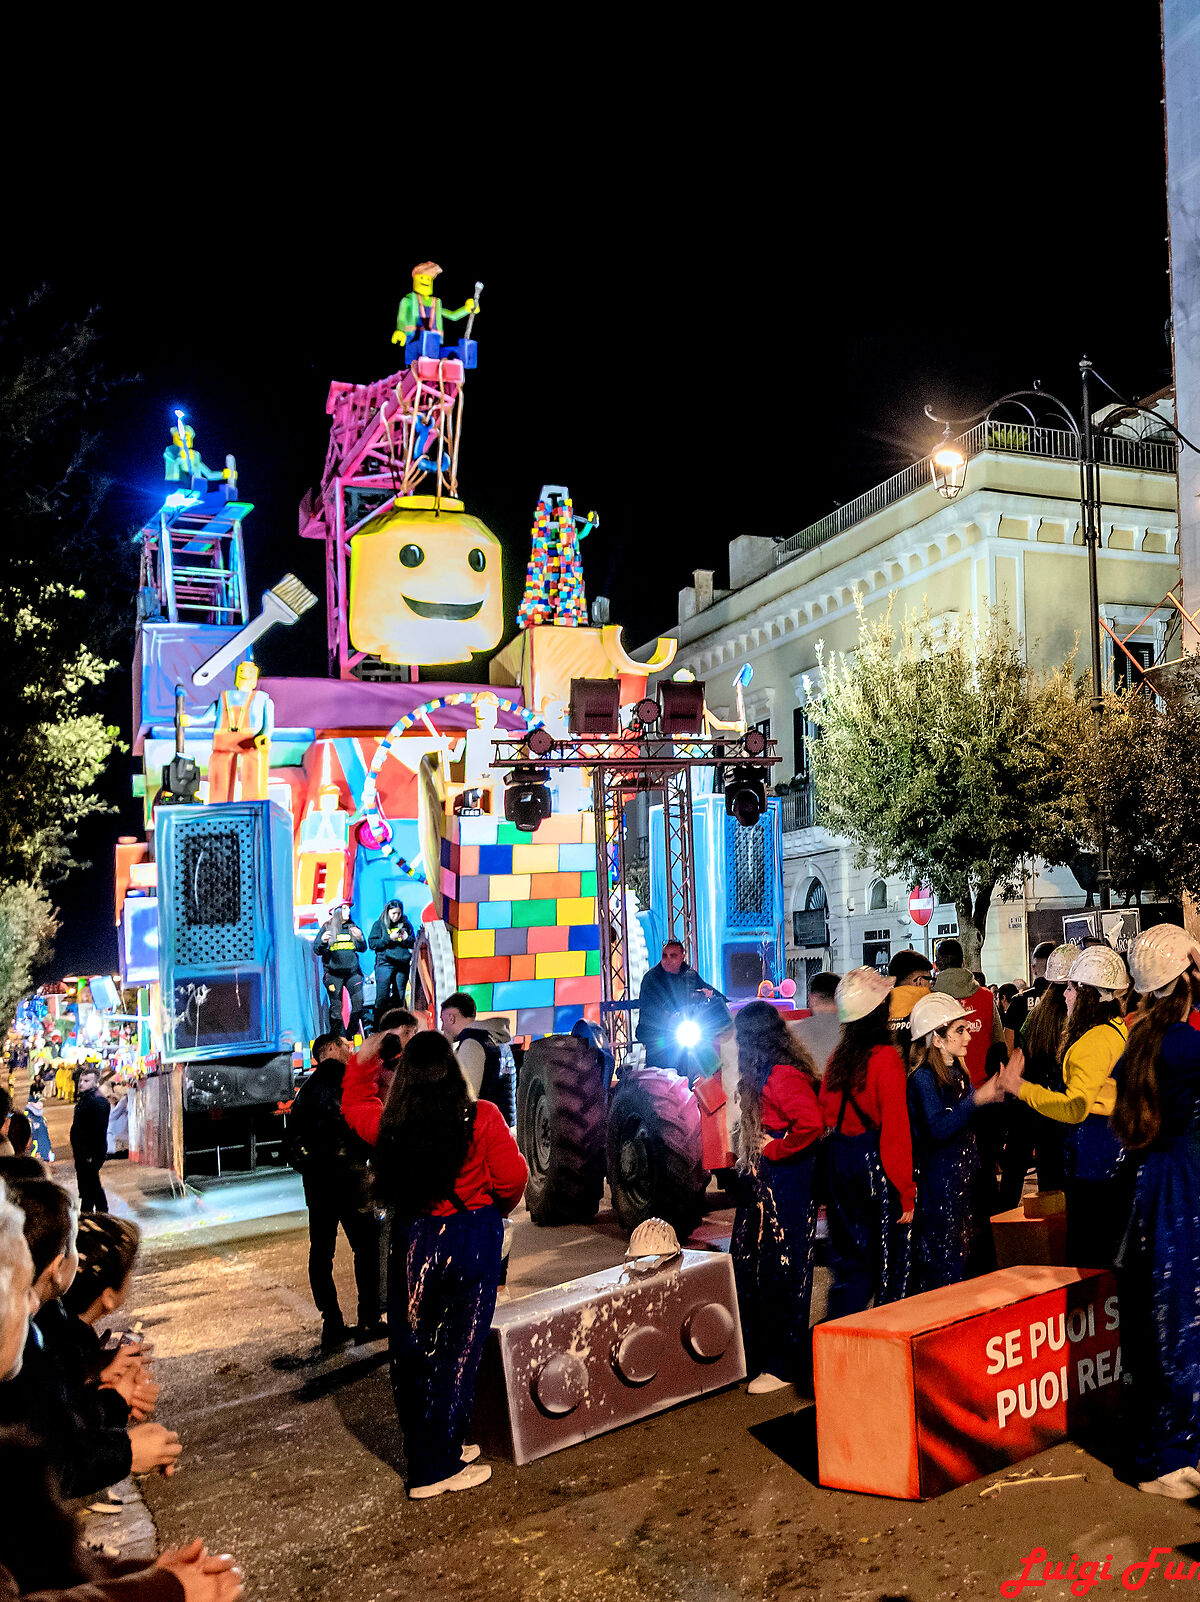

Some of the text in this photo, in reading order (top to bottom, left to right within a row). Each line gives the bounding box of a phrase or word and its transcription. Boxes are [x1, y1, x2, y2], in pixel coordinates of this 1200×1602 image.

[985, 1328, 1024, 1375] SE
[1029, 1303, 1096, 1360] PUOI
[996, 1346, 1123, 1429] PUOI REA
